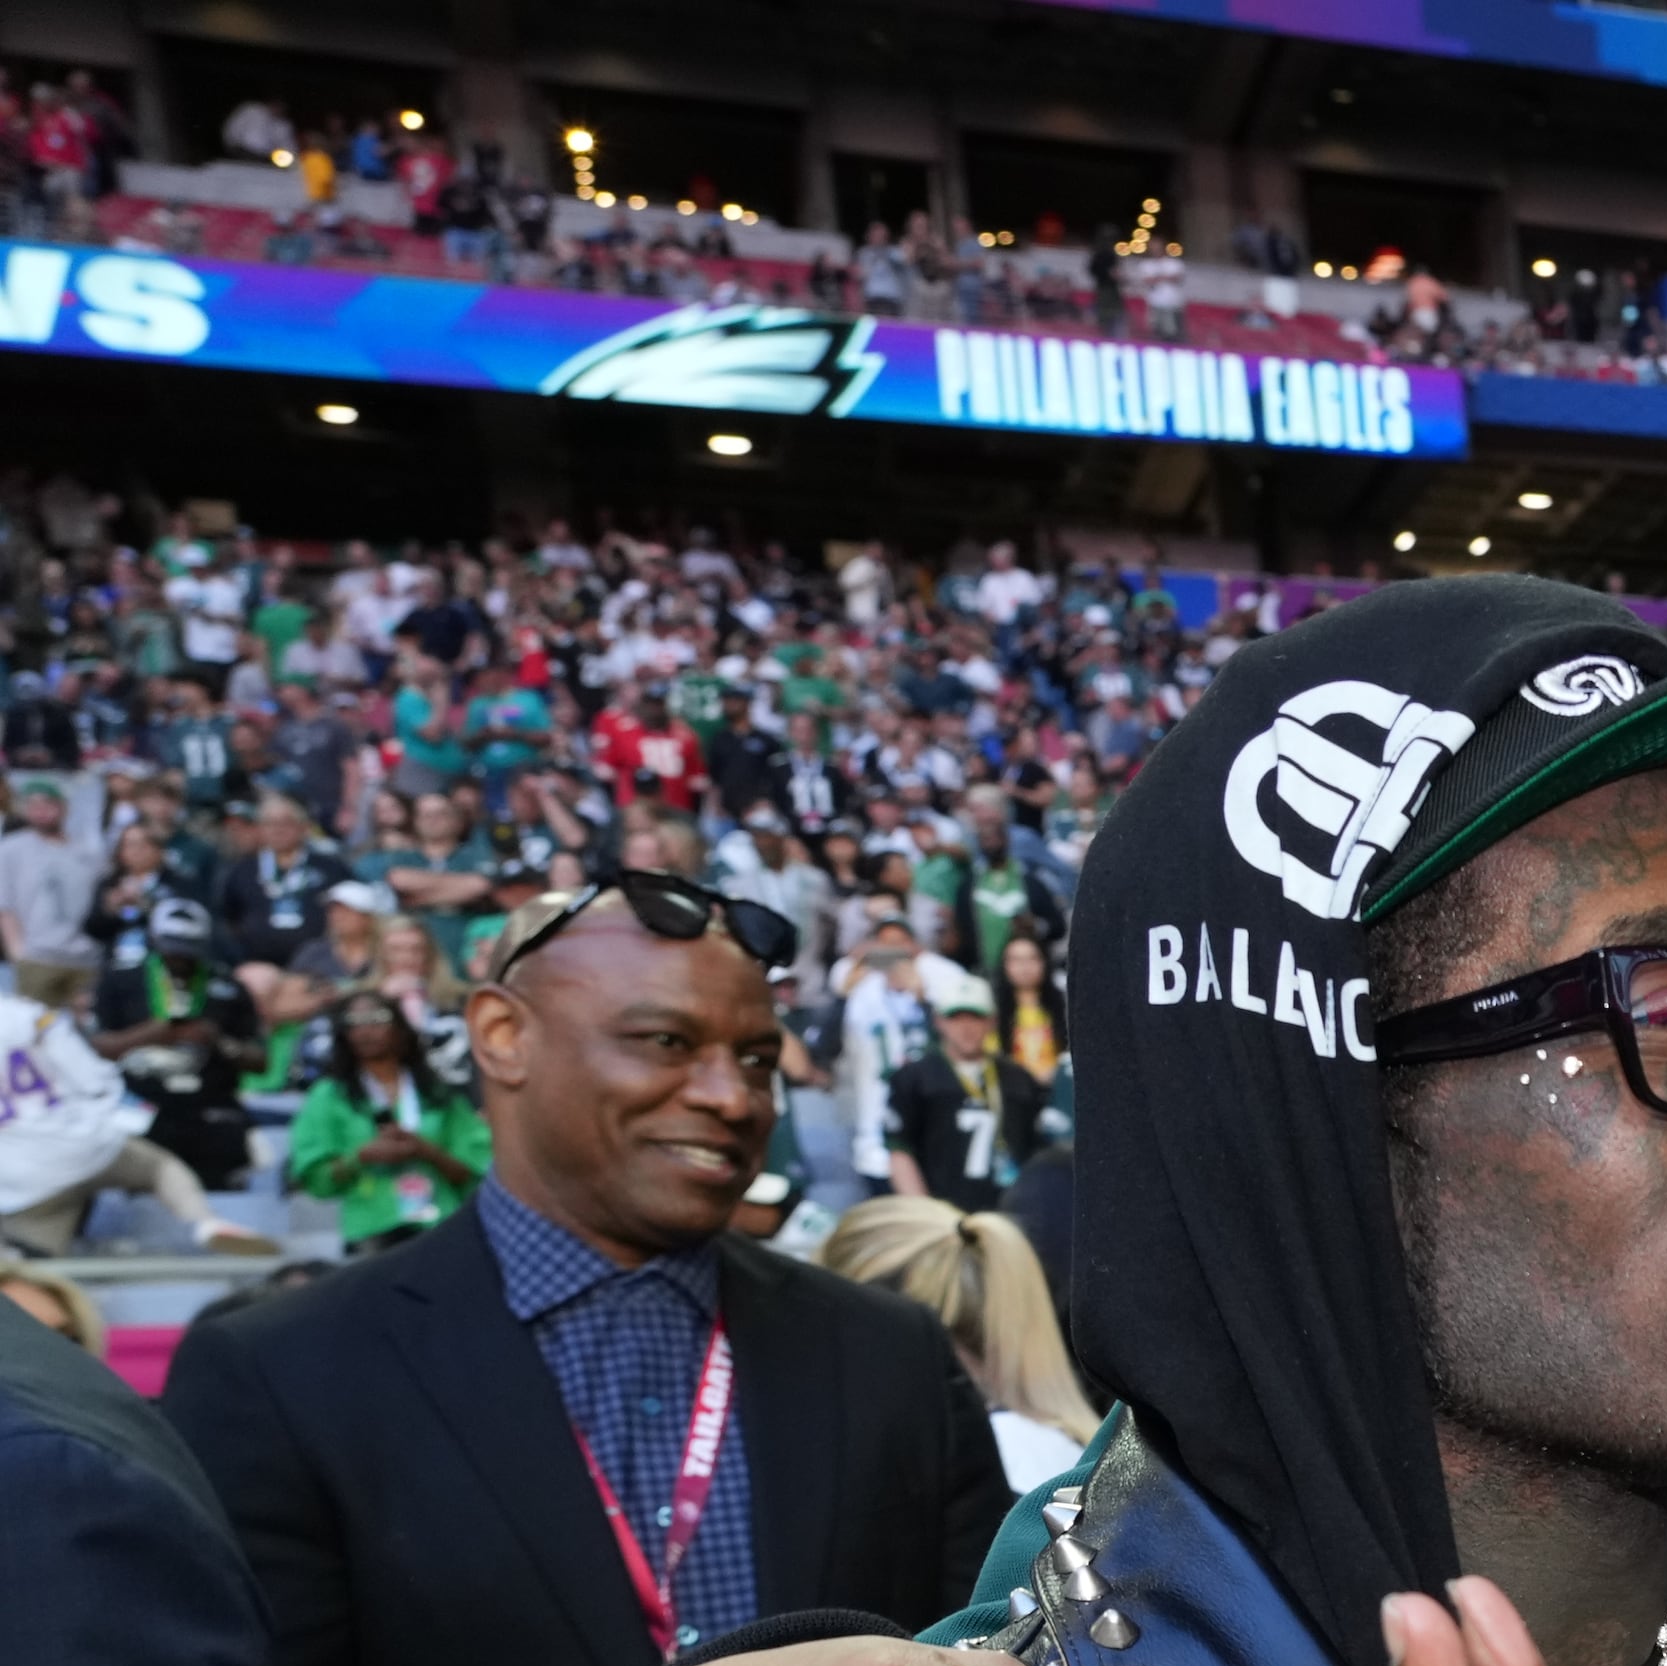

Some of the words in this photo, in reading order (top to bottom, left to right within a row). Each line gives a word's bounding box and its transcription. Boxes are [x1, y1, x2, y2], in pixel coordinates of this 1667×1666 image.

[936, 329, 1254, 442] PHILADELPHIA
[1260, 355, 1414, 453] EAGLES
[1473, 989, 1519, 1013] PRADA
[955, 1109, 996, 1180] 7
